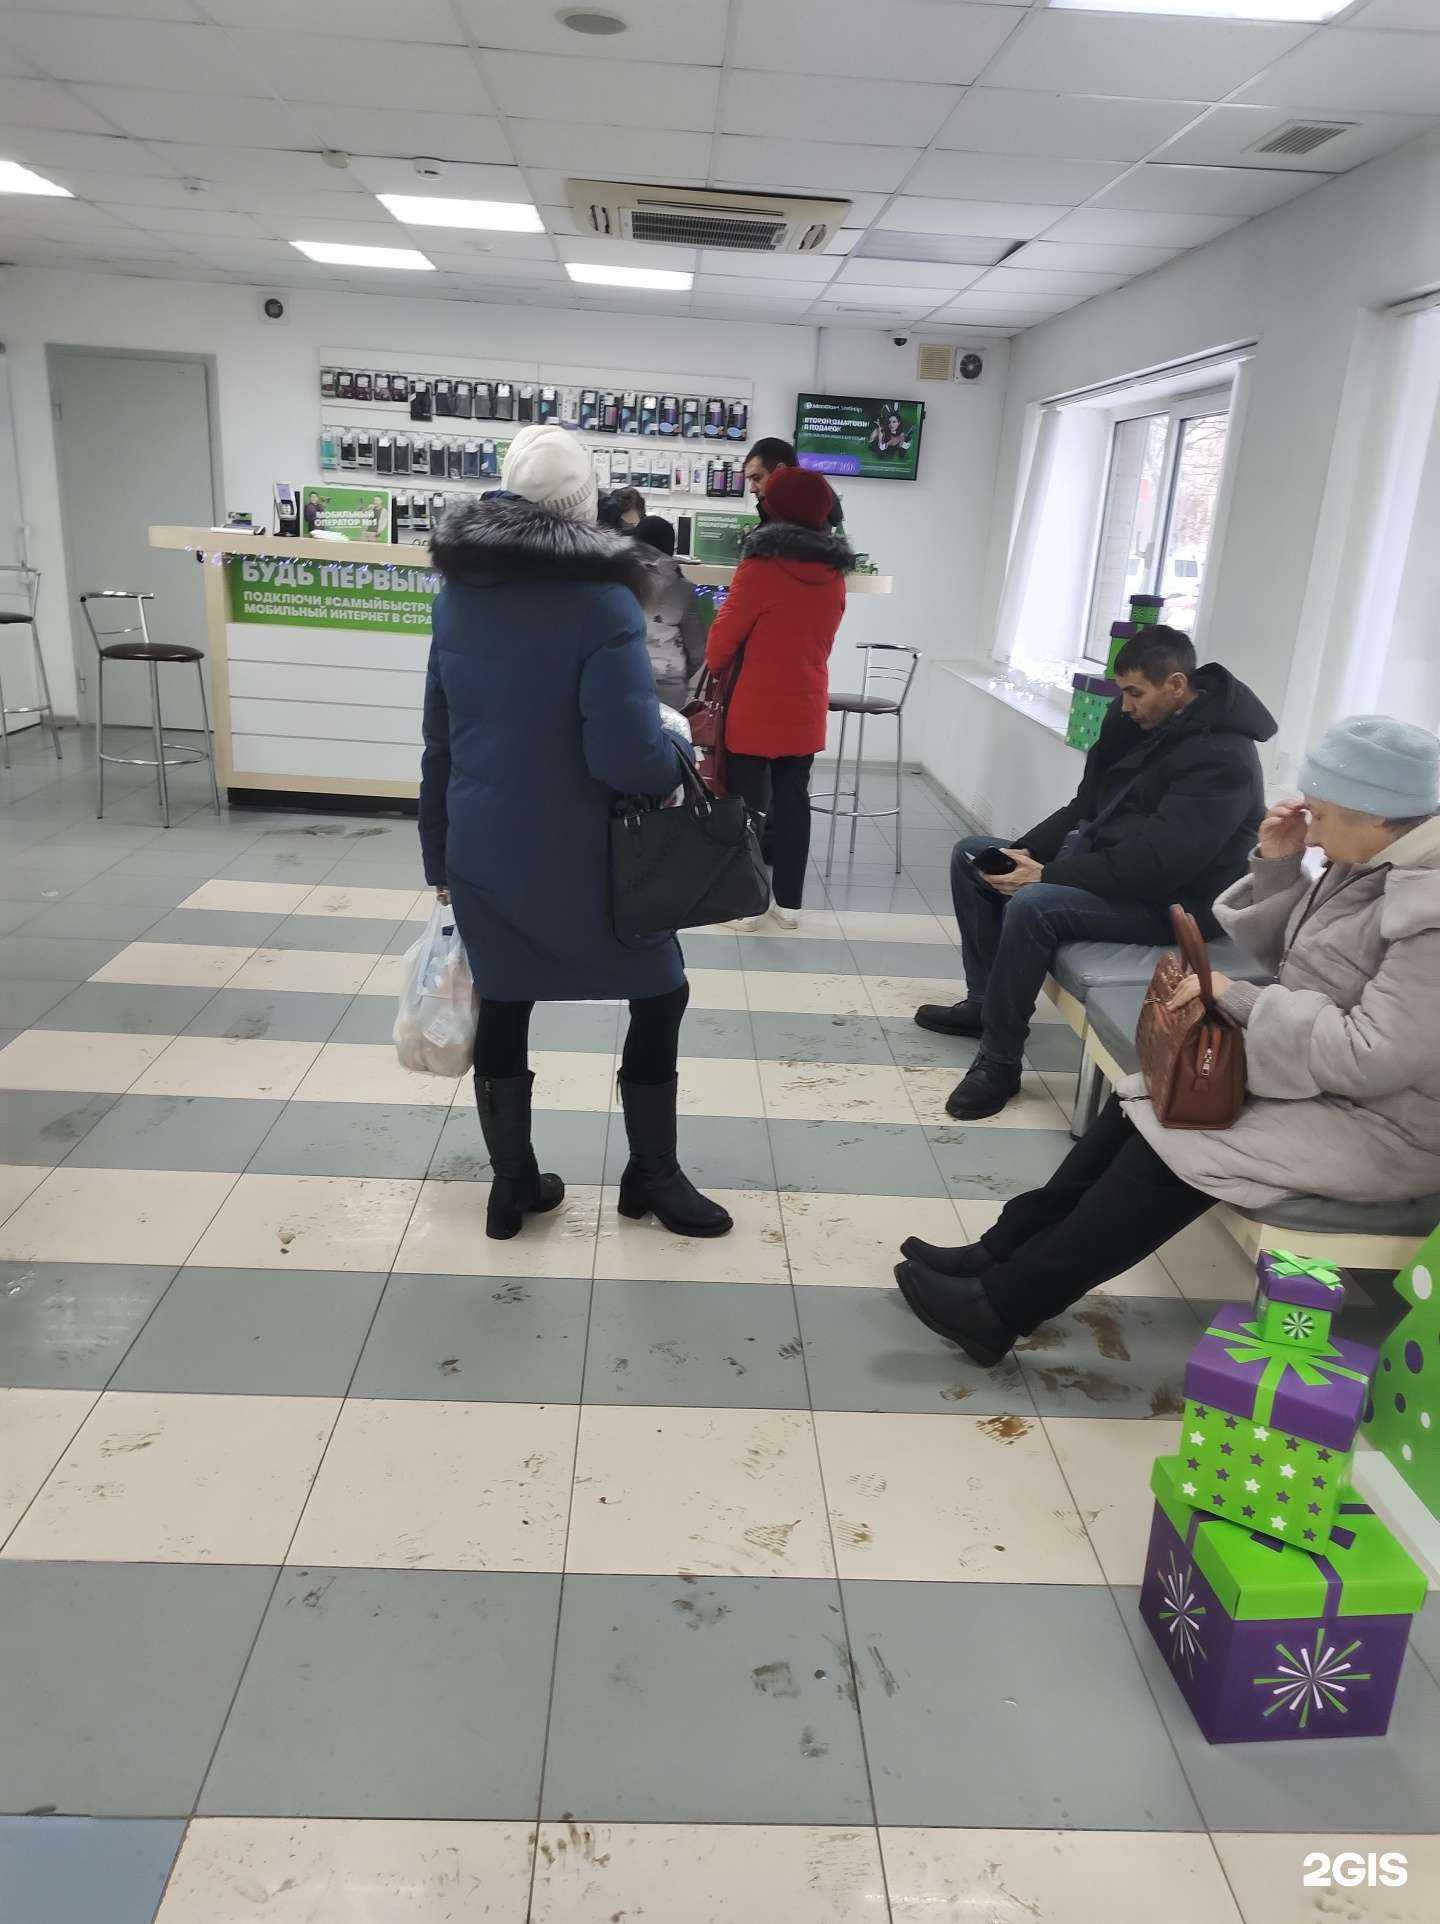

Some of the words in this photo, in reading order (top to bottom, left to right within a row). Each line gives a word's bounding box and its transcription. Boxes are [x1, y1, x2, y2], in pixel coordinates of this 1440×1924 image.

[314, 518, 361, 527] ОПЕРАТОР
[315, 510, 375, 519] МОБИЛЬНЫЙ
[242, 560, 314, 587] БУДЬ
[320, 565, 440, 593] ПЕРВЫМ
[243, 590, 322, 606] ПОДКЛЮЧИ
[244, 603, 328, 618] МОБИЛЬНЫЙ
[330, 609, 389, 622] ИНТЕРНЕТ
[391, 613, 401, 623] В
